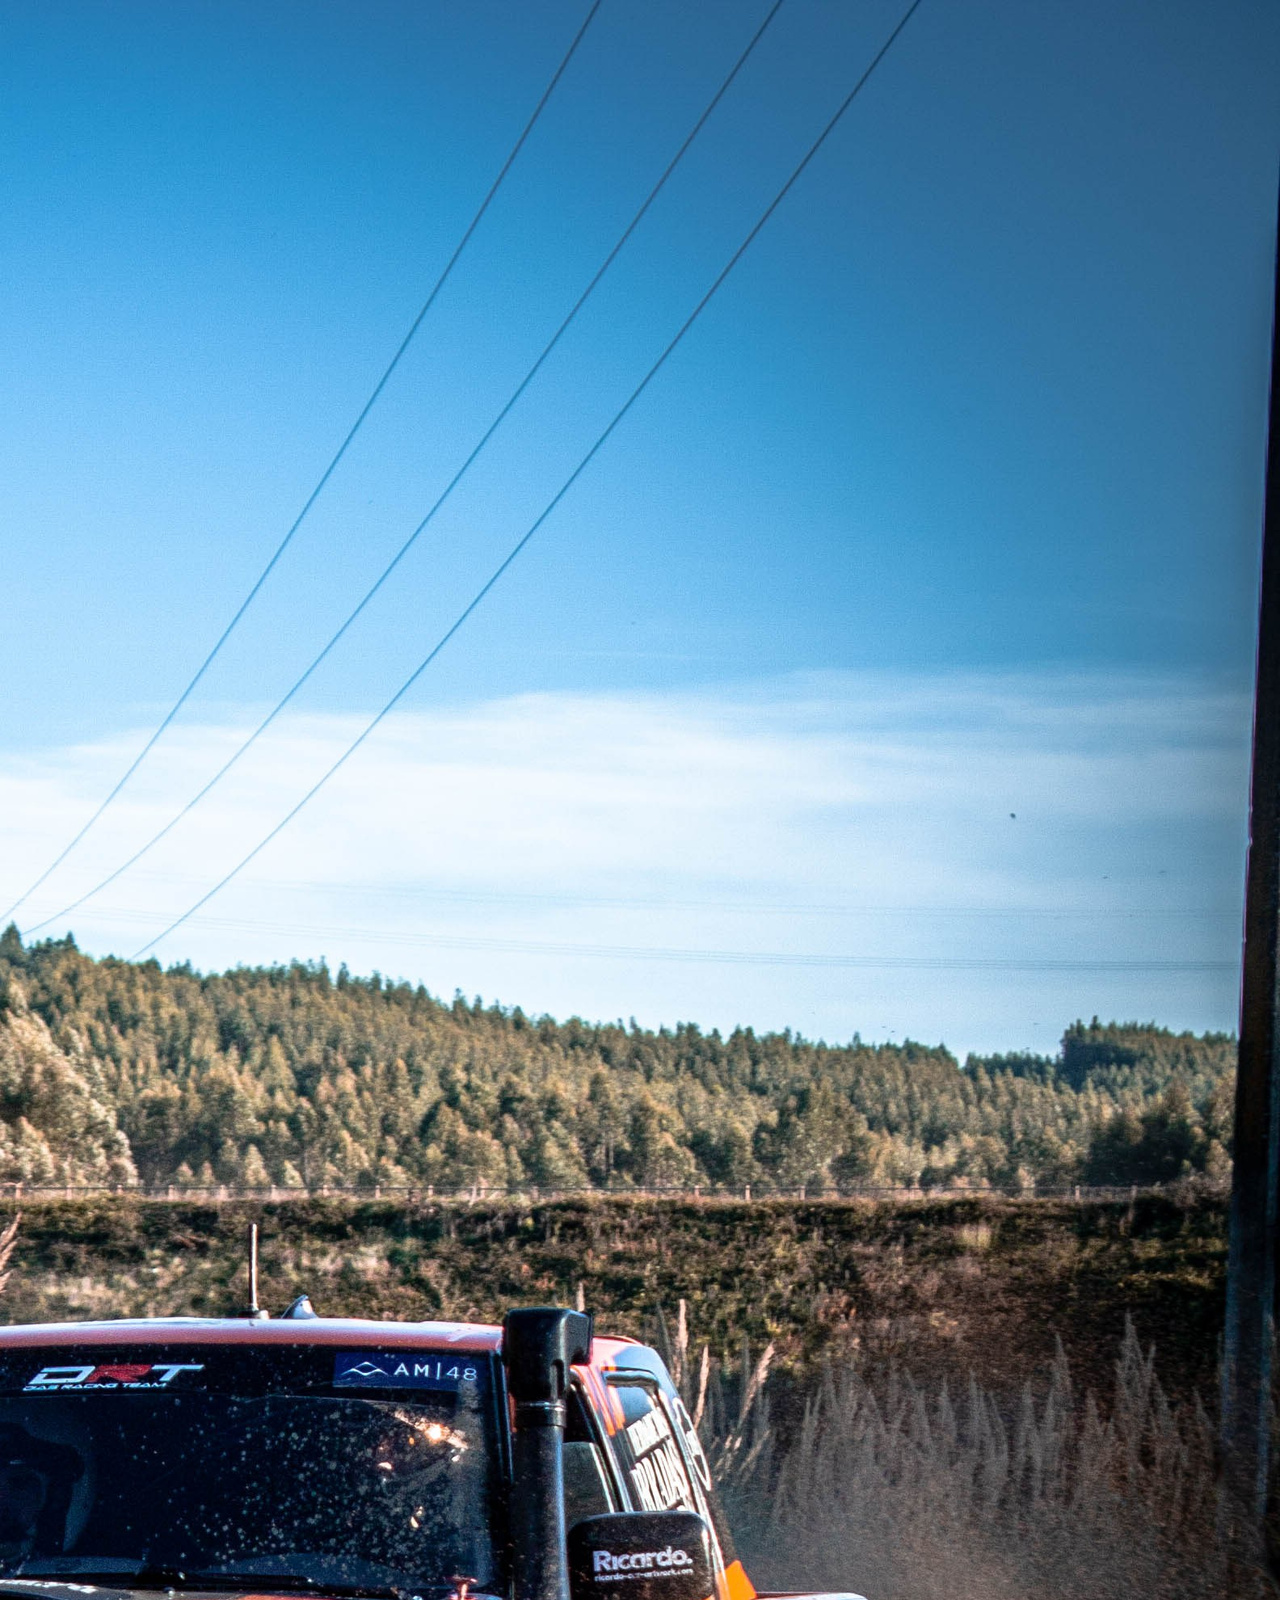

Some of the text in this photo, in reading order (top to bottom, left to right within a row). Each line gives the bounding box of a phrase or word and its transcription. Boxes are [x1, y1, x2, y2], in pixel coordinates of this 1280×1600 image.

[28, 1363, 206, 1385] DRT
[60, 1382, 119, 1391] RACING
[121, 1381, 167, 1389] TEAM
